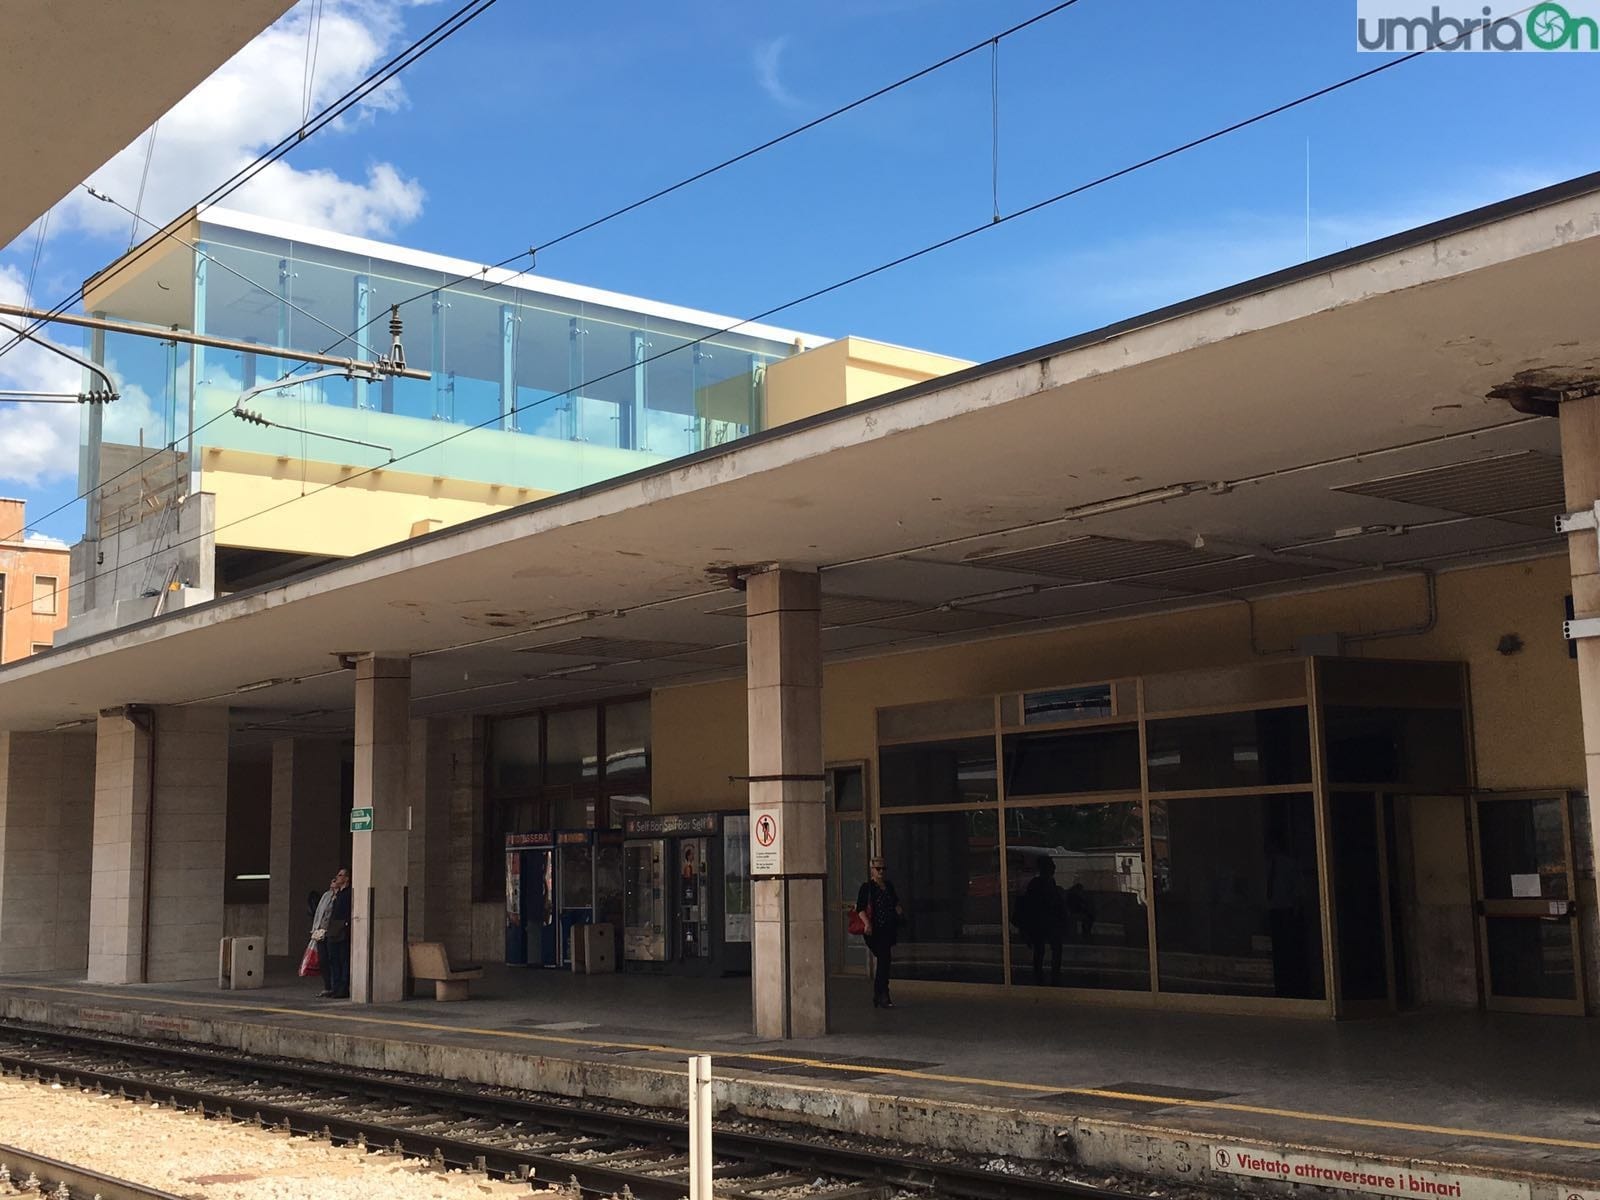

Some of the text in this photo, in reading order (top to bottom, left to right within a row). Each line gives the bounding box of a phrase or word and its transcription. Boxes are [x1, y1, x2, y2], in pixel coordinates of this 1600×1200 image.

[636, 821, 649, 832] Self
[650, 821, 662, 831] Bar
[1236, 1153, 1462, 1197] Vietato attraversare i binari
